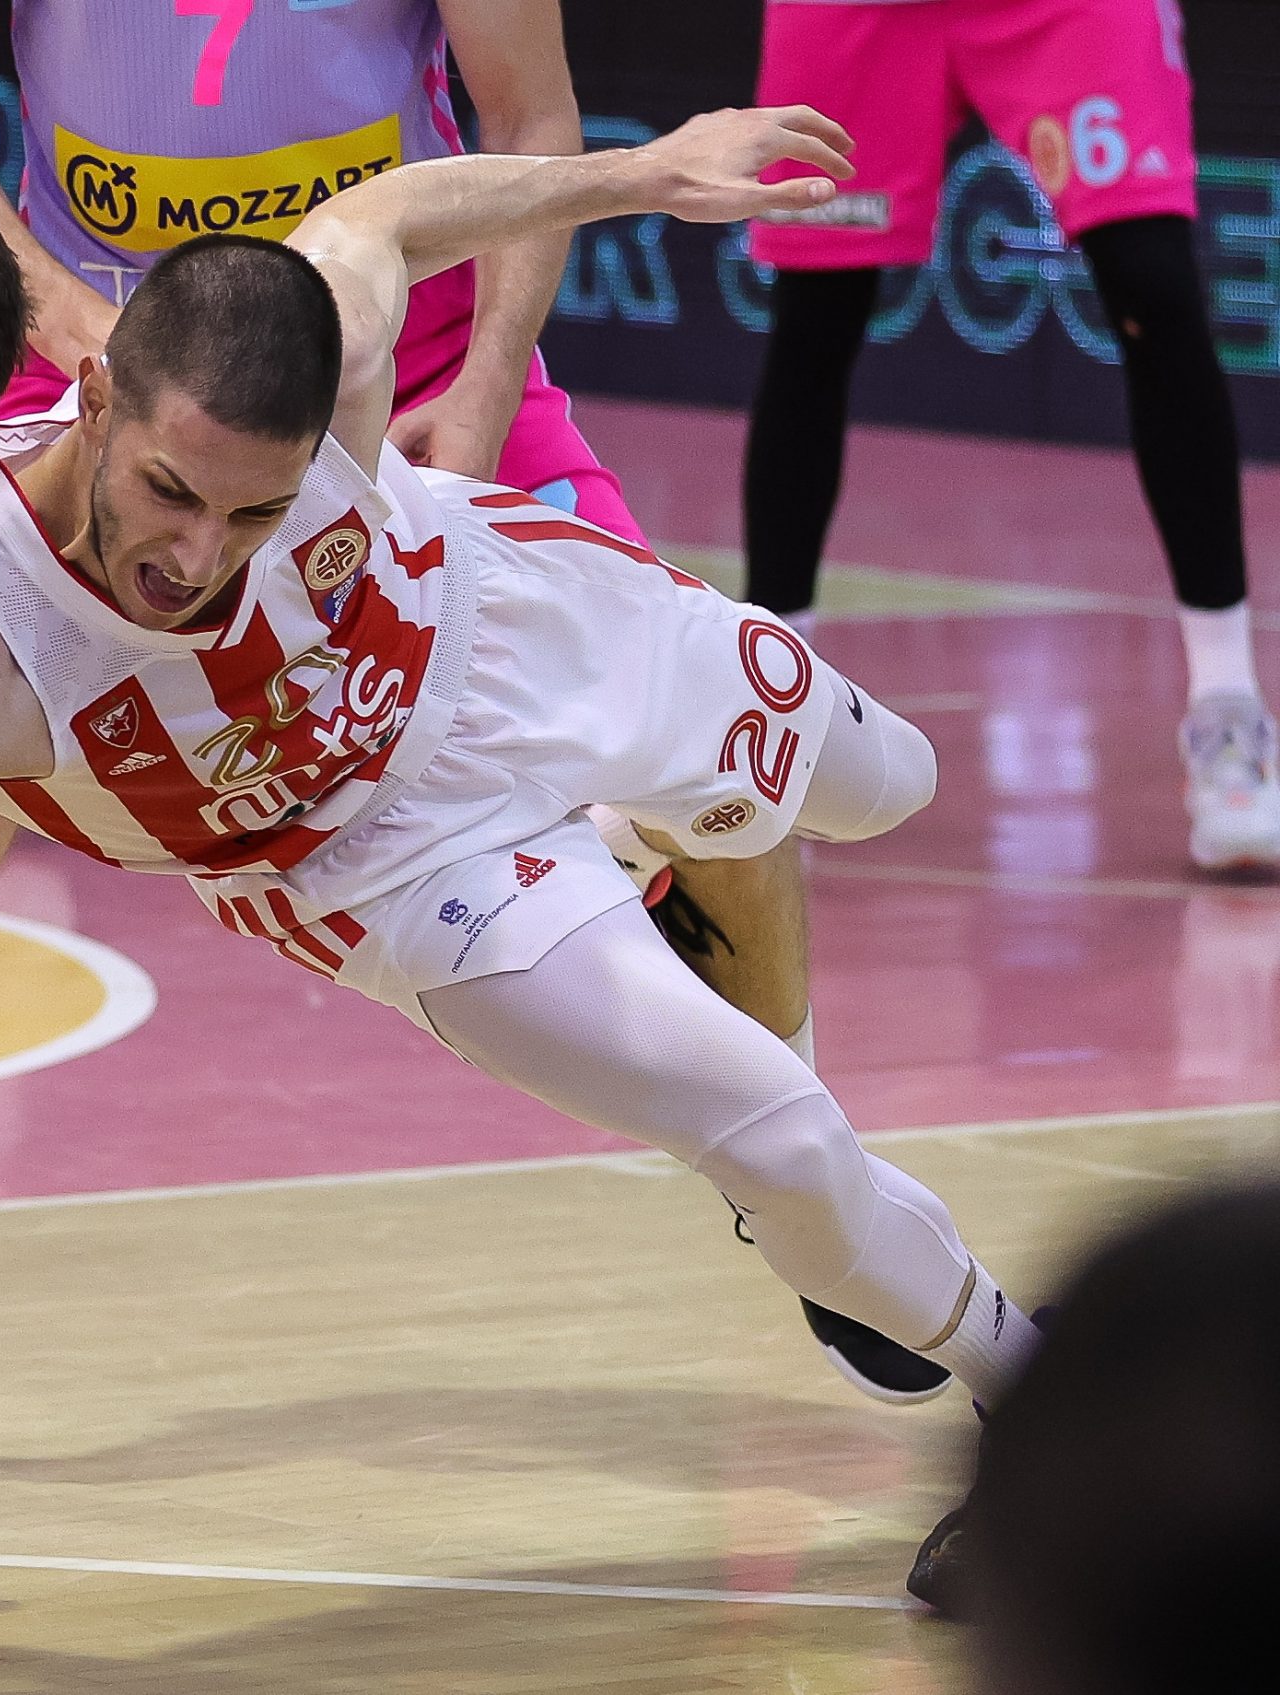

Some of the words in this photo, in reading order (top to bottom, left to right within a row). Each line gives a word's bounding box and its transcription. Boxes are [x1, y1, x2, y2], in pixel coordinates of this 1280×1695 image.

[717, 618, 813, 806] 20
[108, 754, 168, 776] adidas
[519, 858, 557, 888] adidas
